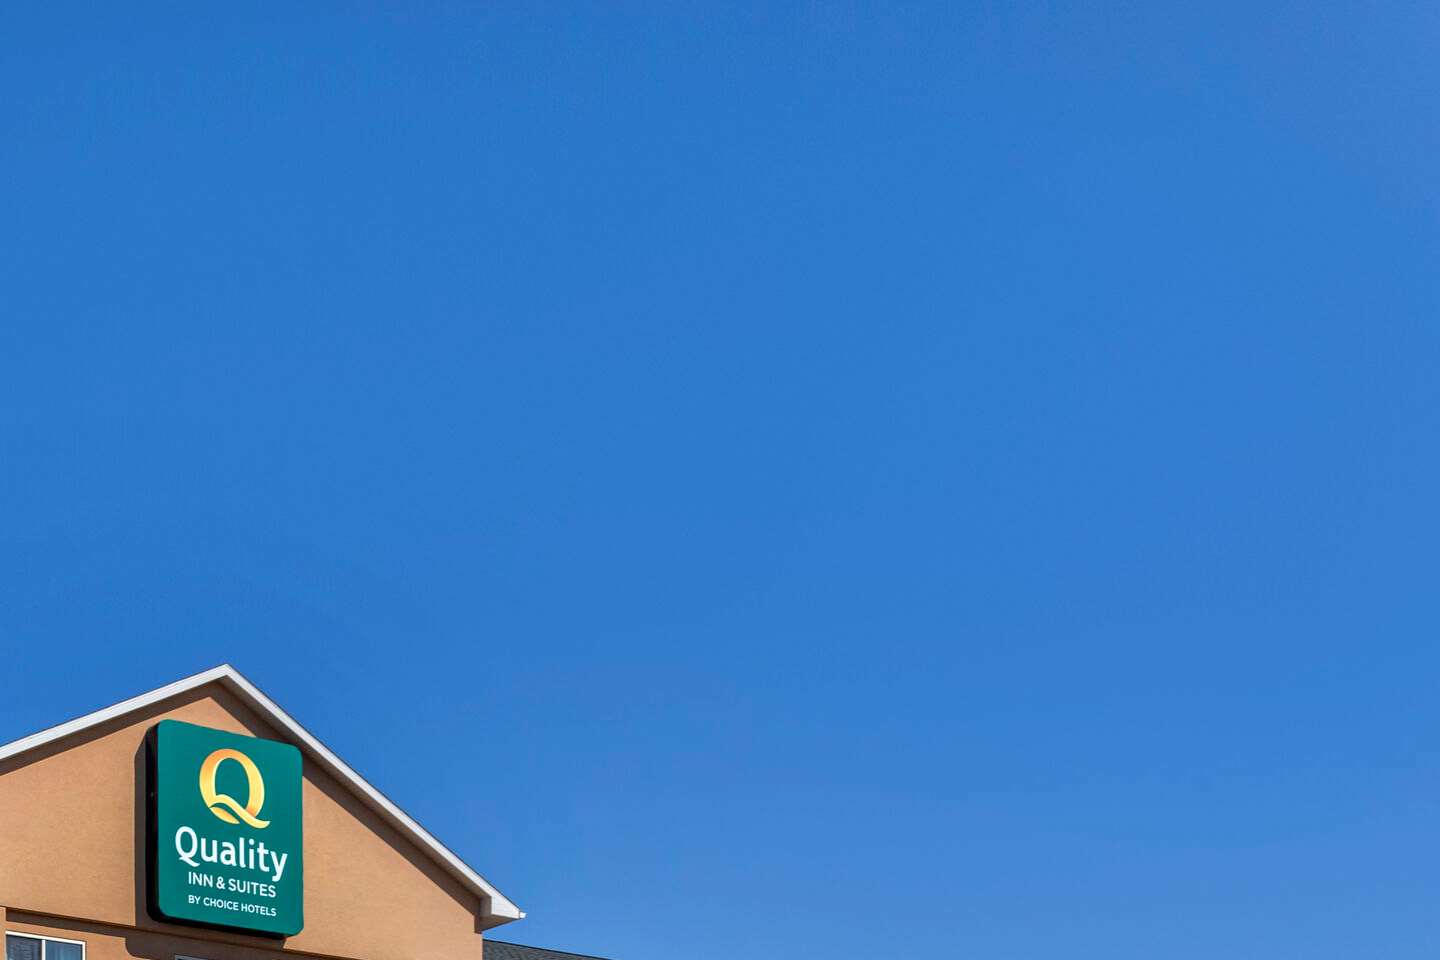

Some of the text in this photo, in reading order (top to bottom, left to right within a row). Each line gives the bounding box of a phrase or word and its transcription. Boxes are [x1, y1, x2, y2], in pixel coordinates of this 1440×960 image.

[199, 748, 271, 829] Q
[175, 826, 288, 882] Quality
[188, 871, 276, 898] INN & SUITES
[188, 894, 277, 917] BY CHOICE HOTELS
